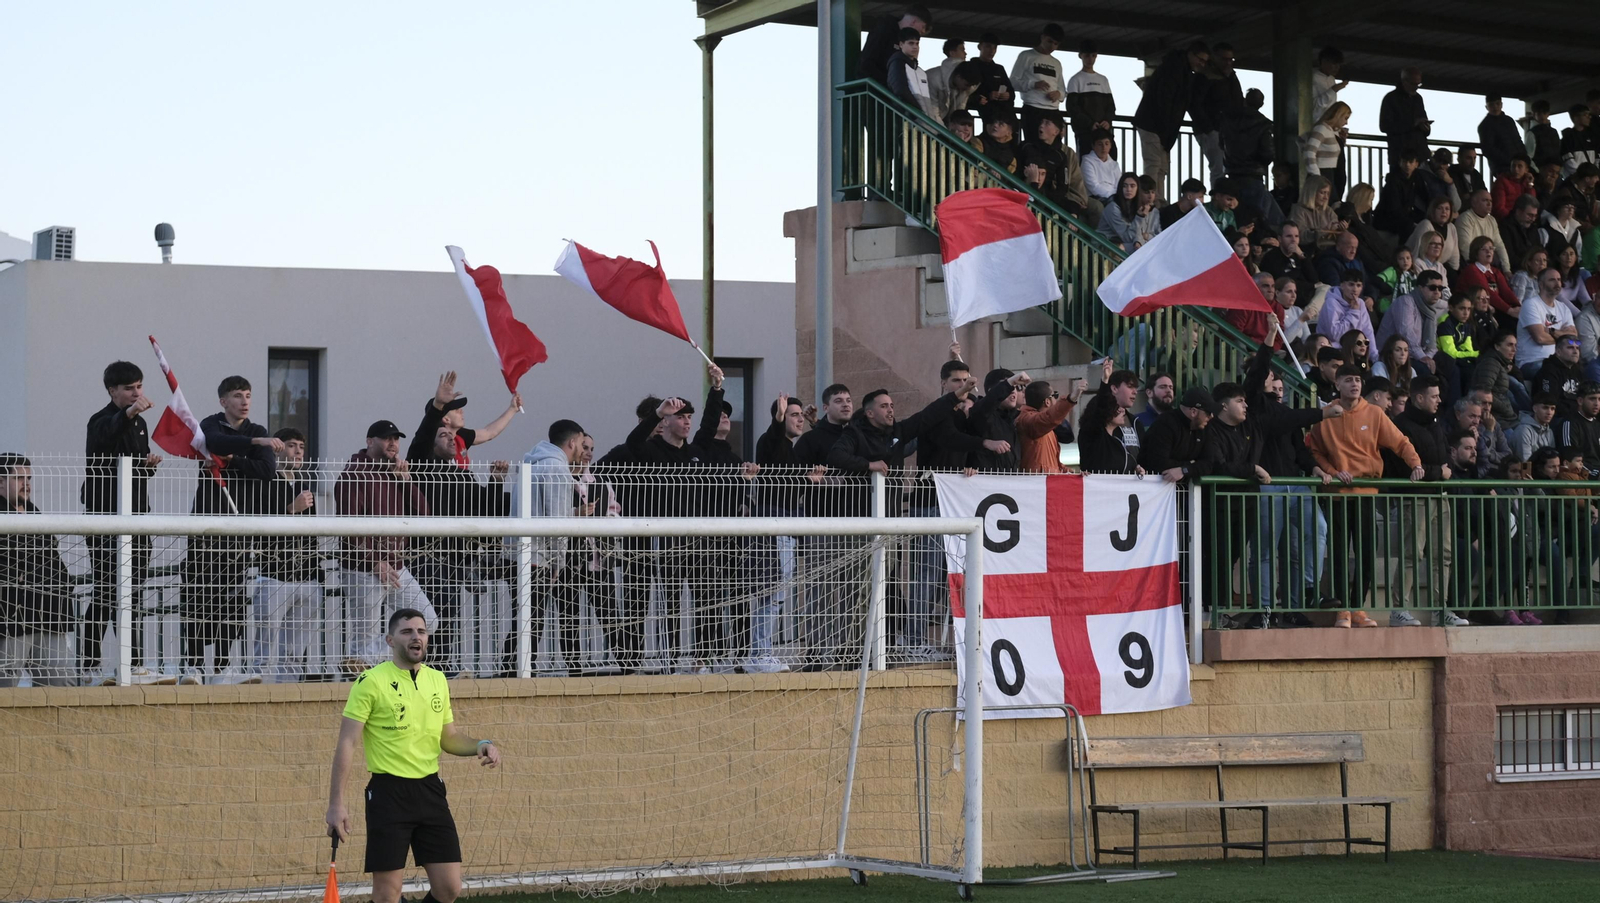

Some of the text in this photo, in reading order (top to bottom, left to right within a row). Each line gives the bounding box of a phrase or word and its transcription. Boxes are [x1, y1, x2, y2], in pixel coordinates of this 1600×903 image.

[974, 493, 1140, 553] G J
[1118, 631, 1154, 689] 9
